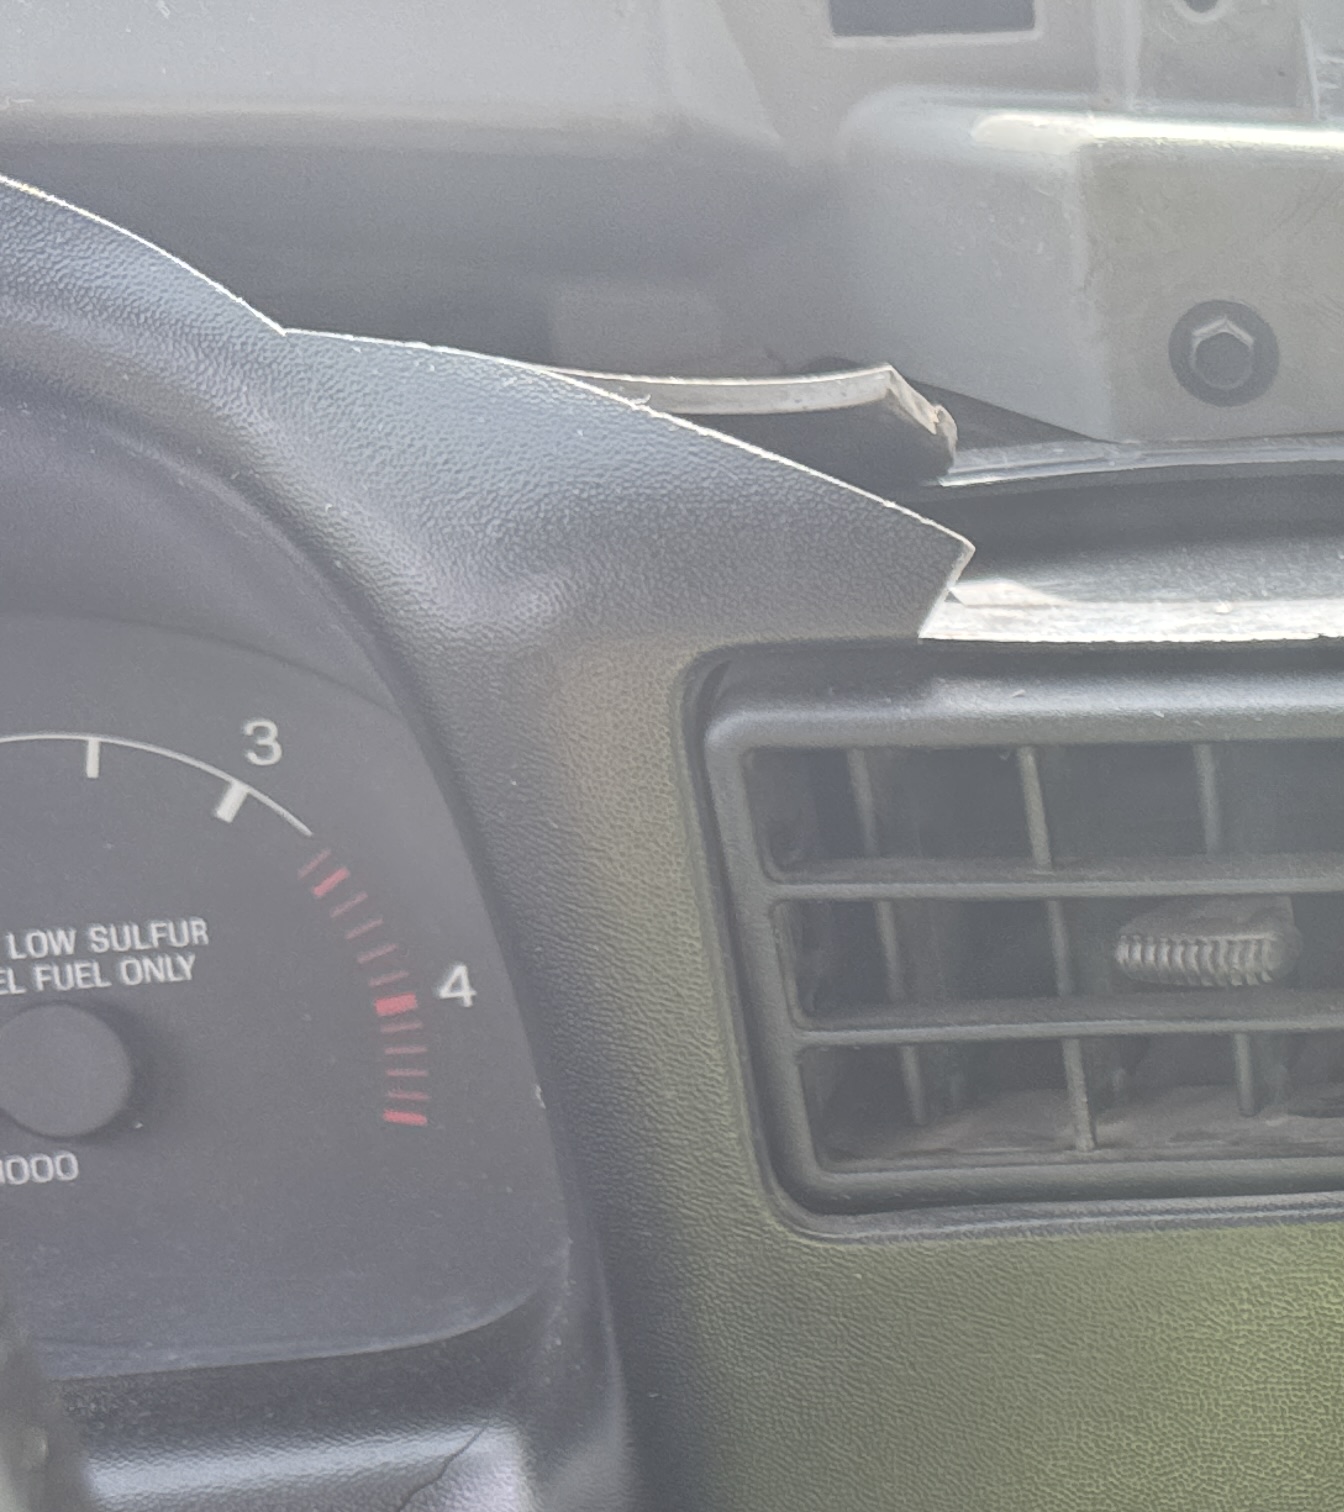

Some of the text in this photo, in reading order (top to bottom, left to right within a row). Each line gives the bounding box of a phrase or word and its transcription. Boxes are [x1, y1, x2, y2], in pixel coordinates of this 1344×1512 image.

[242, 719, 283, 765] 3
[4, 916, 210, 960] LOW SULFUR
[31, 959, 112, 992] FUEL
[118, 952, 196, 986] ONLY
[439, 965, 477, 1008] 4
